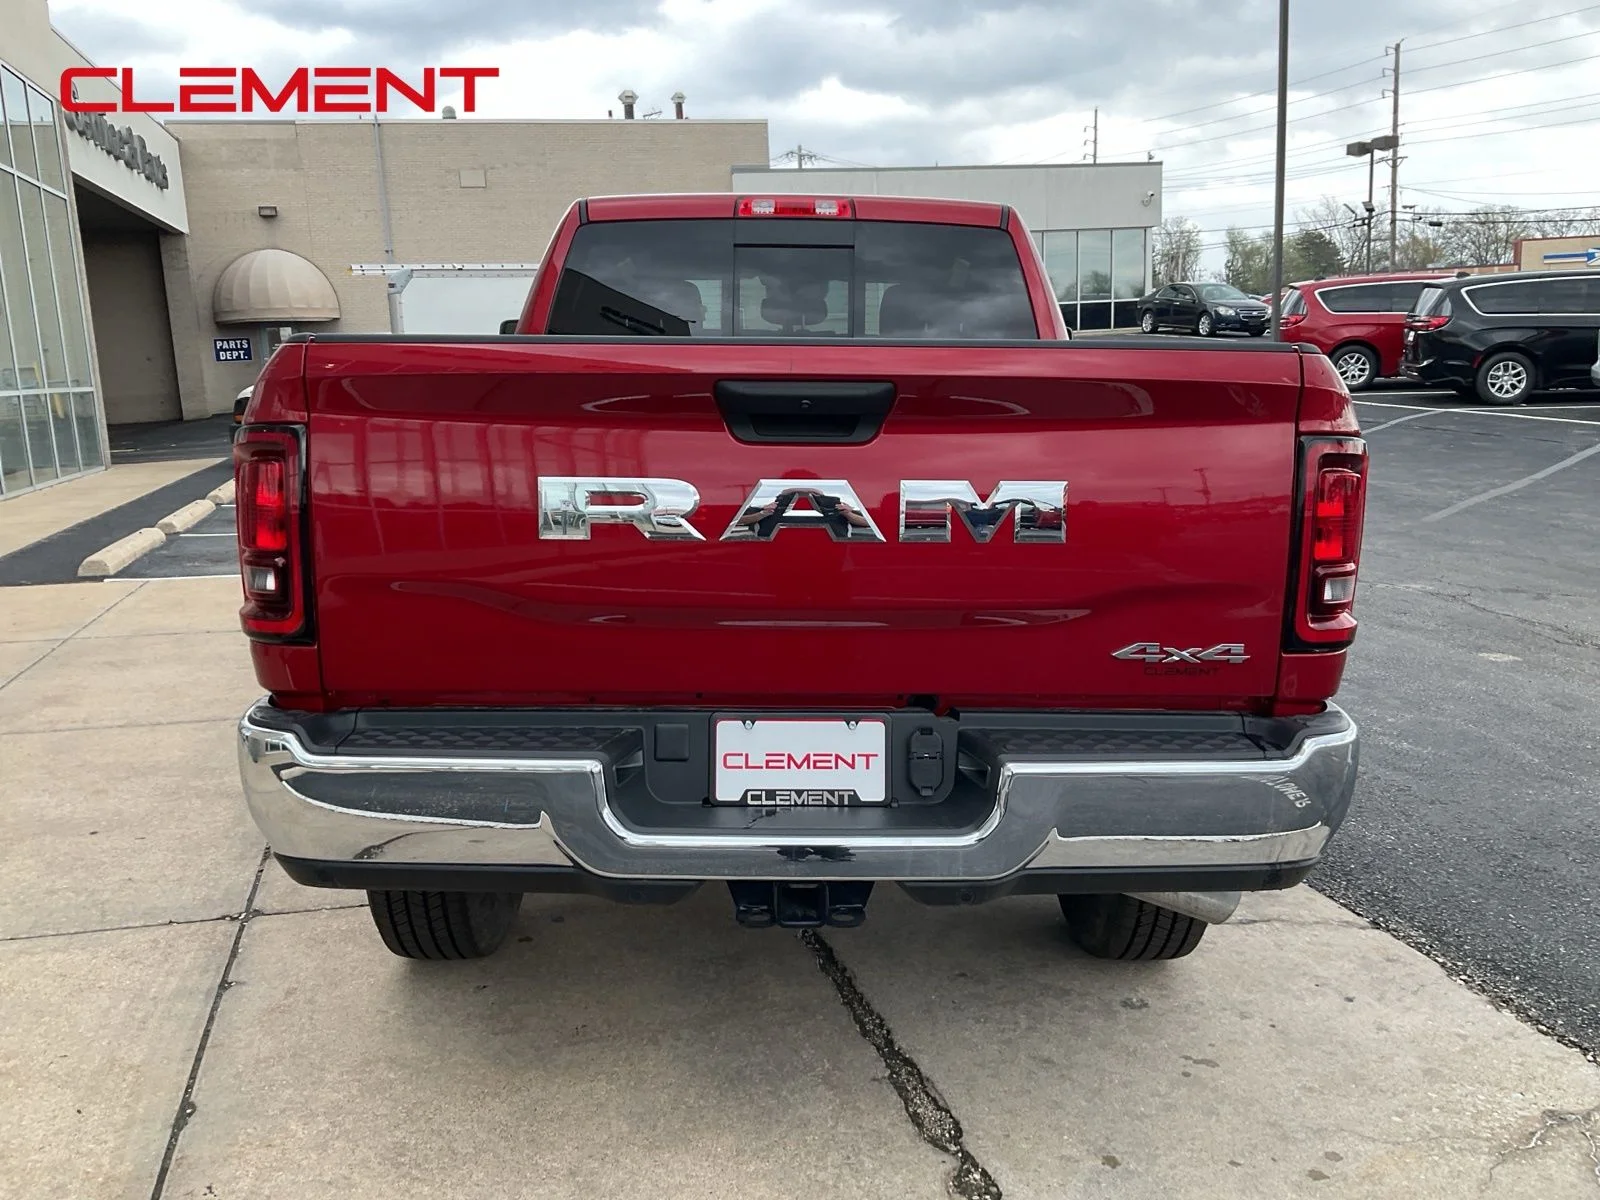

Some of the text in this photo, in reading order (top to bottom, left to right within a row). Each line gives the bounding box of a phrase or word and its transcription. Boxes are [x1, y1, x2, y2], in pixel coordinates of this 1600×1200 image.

[216, 340, 249, 349] PARTS
[219, 350, 248, 360] DEPT.
[538, 476, 1069, 544] RAM
[1144, 667, 1220, 676] CLEMENT
[722, 752, 879, 770] CLEMENT
[747, 790, 854, 806] CLEMENT
